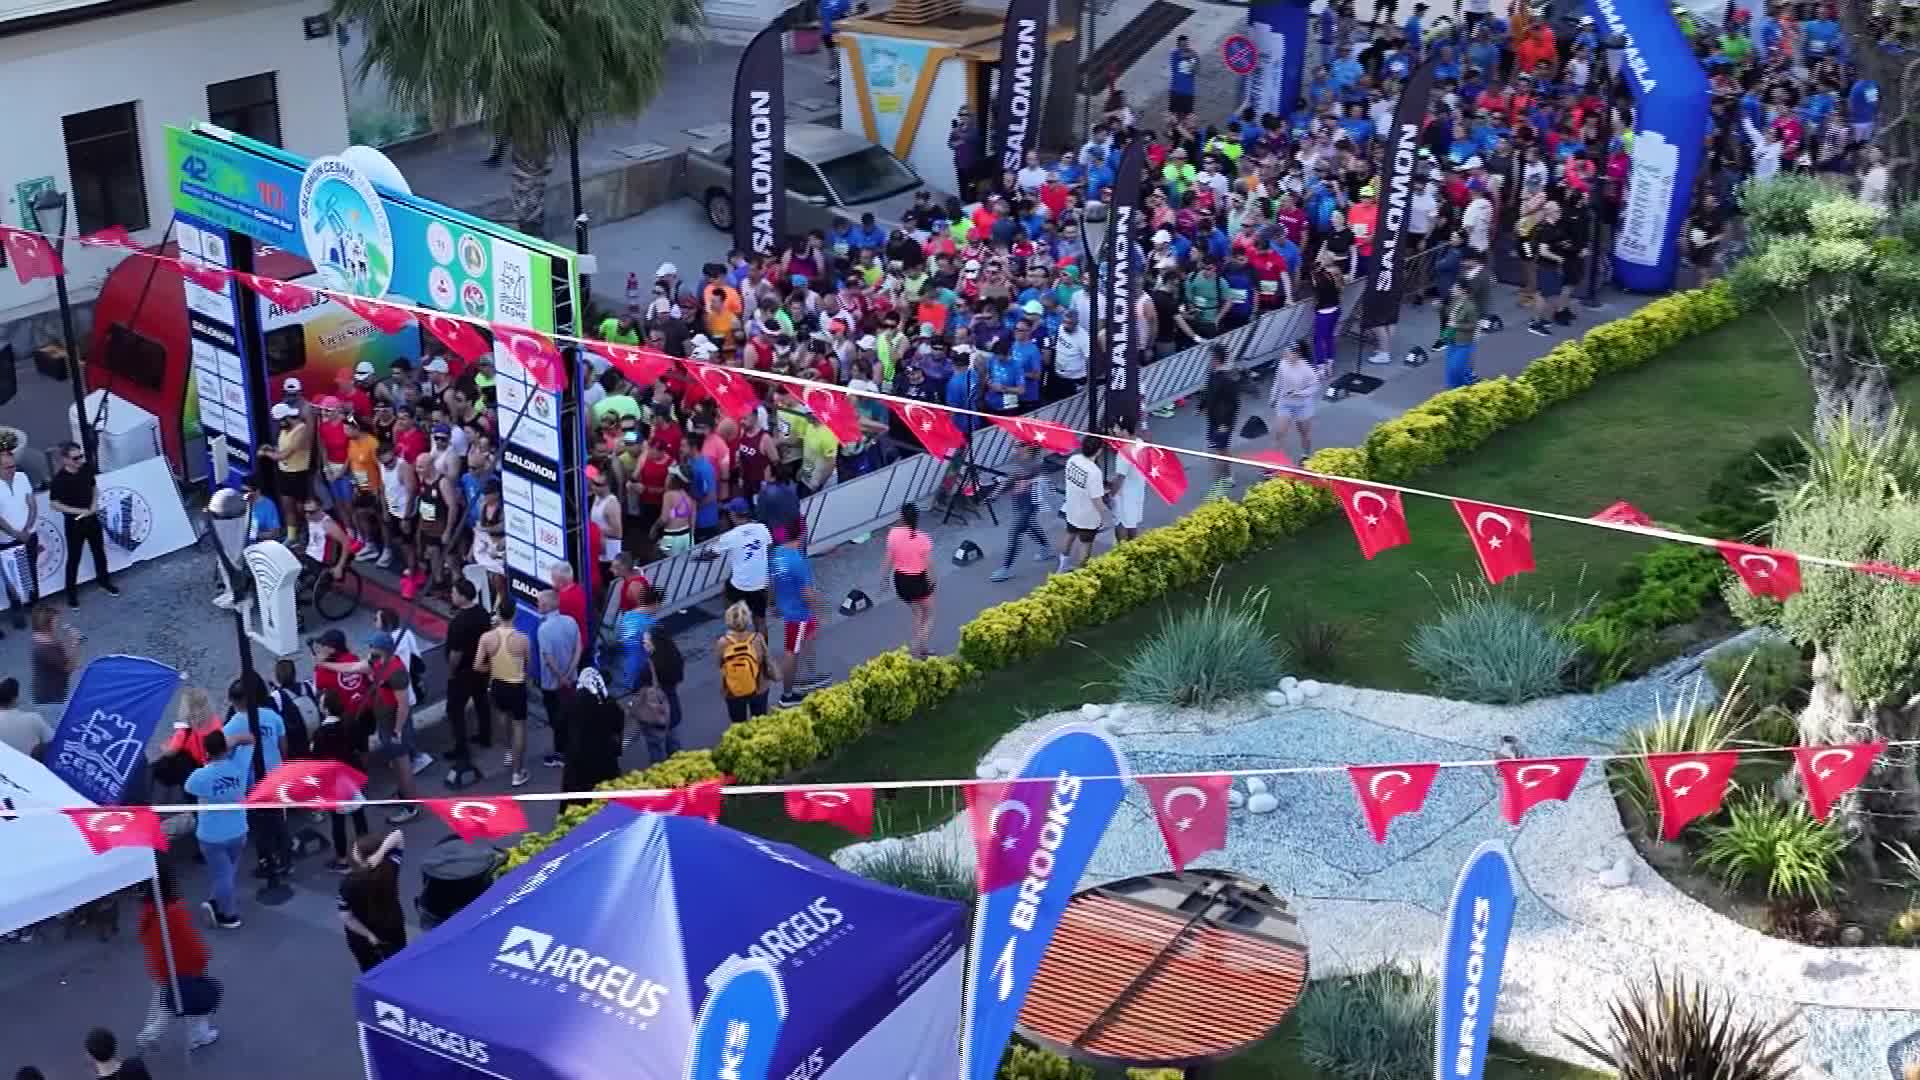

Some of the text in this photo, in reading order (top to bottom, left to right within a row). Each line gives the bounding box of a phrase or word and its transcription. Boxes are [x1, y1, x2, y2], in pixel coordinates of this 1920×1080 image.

[750, 91, 772, 255] SALOMON
[1002, 19, 1037, 171] SALOMON
[1376, 123, 1416, 291] SALOMON
[1109, 205, 1131, 391] SALOMON
[503, 450, 557, 482] SALOMON
[1009, 769, 1081, 932] BROOKS
[537, 943, 670, 1017] ARGEUS
[748, 896, 844, 966] ARGEUS
[1455, 897, 1490, 1077] BROOKS
[406, 1016, 490, 1064] ARGEUS
